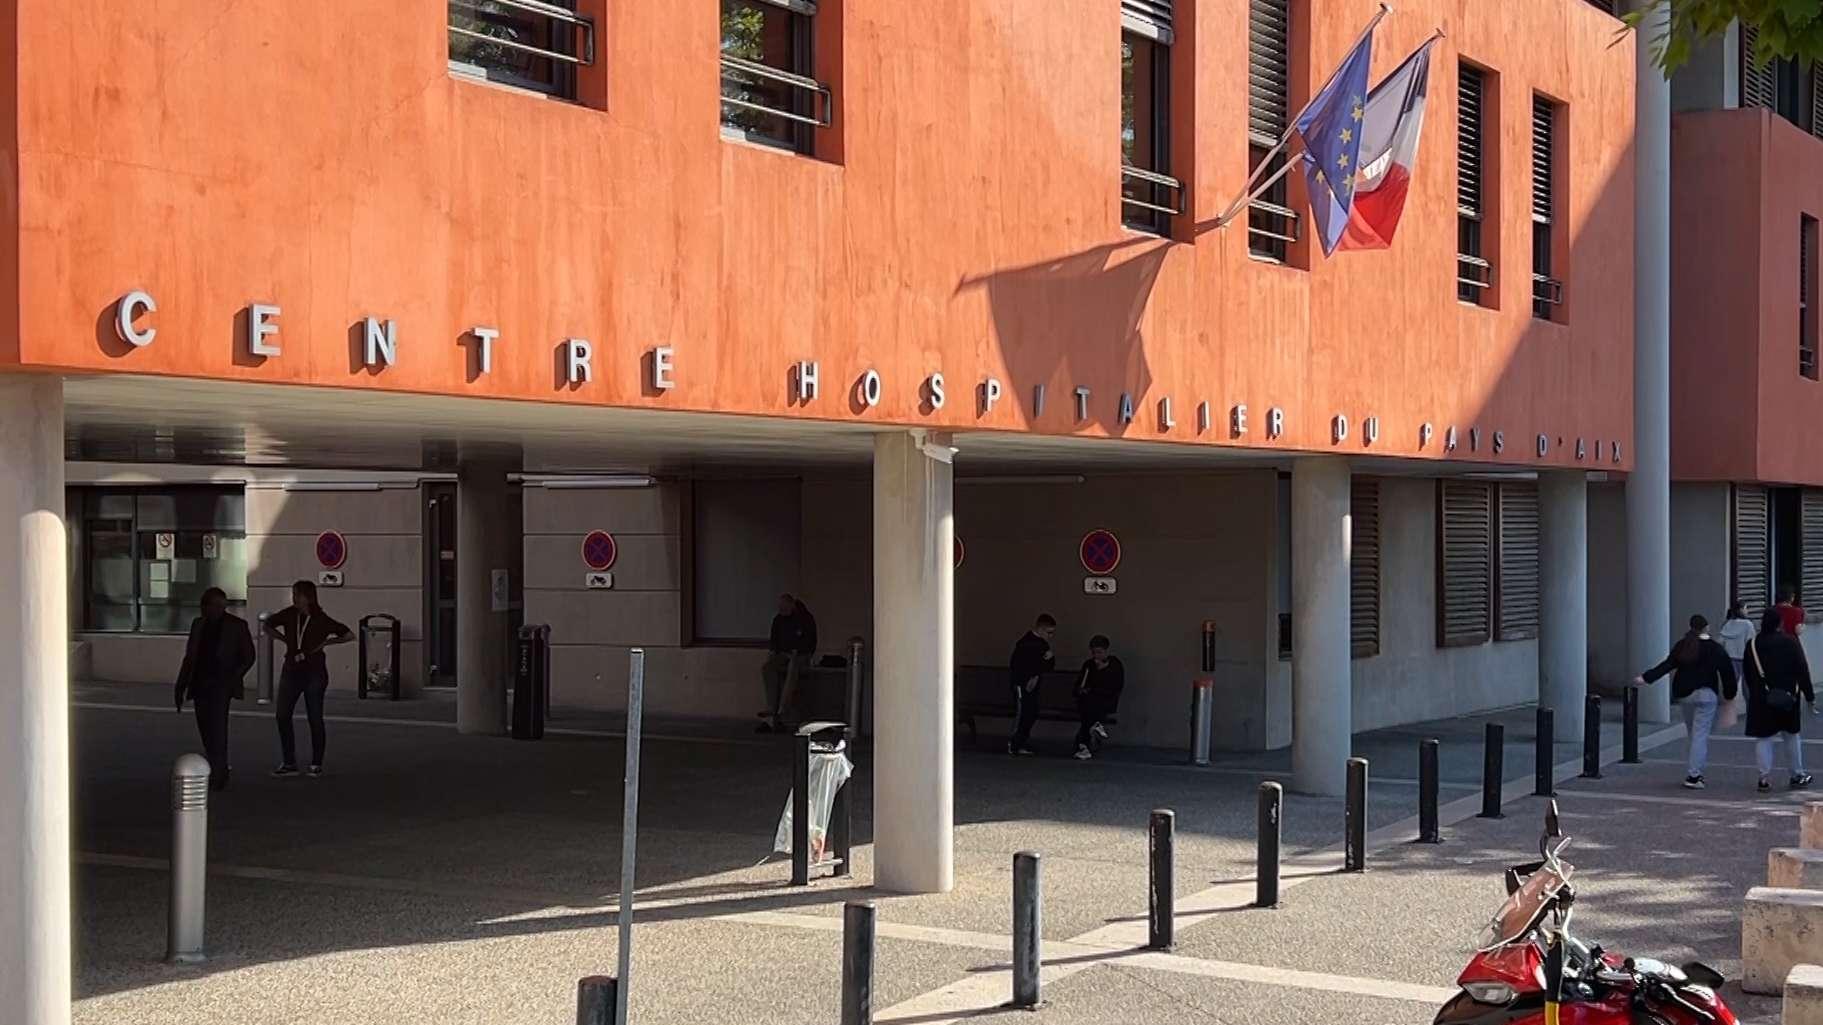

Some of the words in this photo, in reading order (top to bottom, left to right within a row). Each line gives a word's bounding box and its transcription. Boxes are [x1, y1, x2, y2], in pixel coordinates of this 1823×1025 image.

[116, 290, 676, 390] CENTRE
[798, 360, 1284, 437] HOSPITALIER
[1334, 414, 1379, 443] DU
[1421, 423, 1504, 454] PAYS
[1537, 433, 1622, 463] D'AIX
